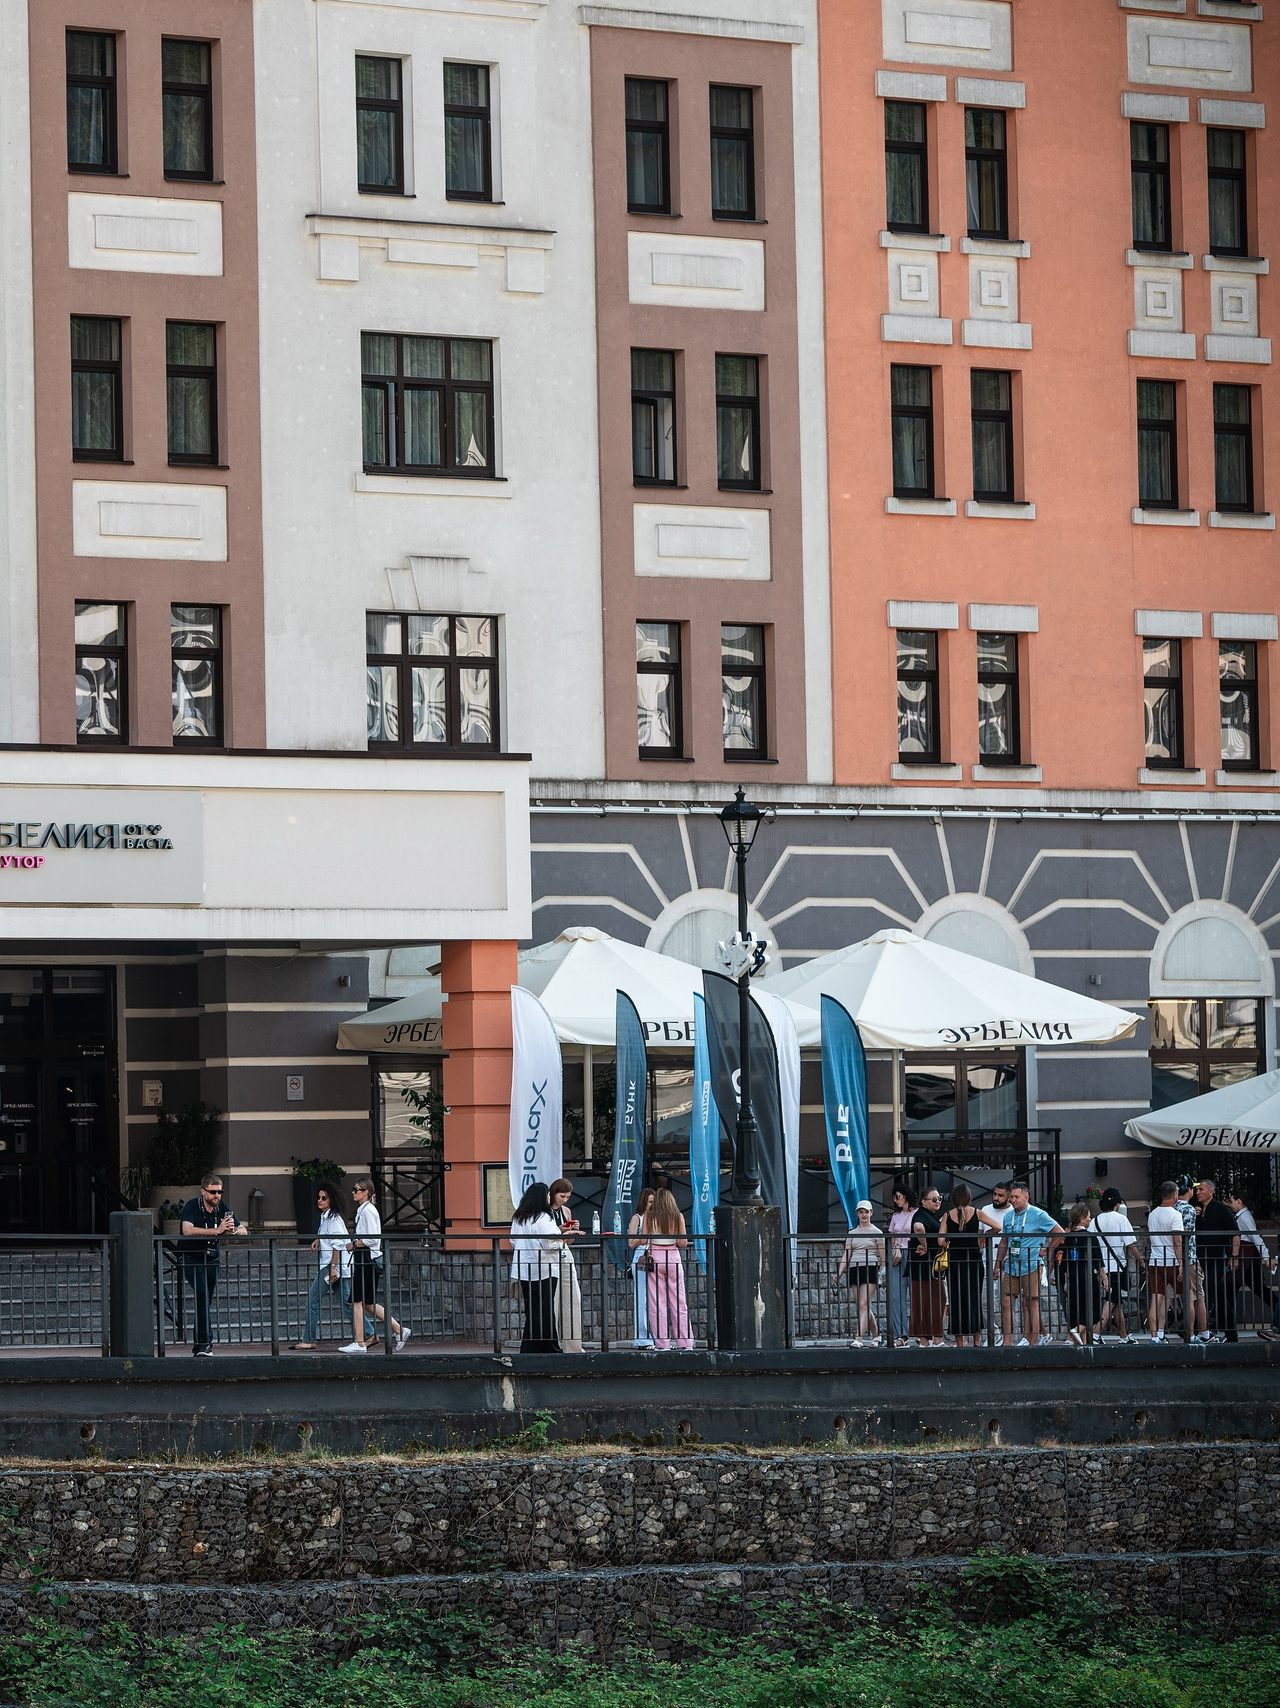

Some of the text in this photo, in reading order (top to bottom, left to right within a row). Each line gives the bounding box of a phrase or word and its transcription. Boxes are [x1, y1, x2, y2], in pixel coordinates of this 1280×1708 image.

[123, 824, 147, 836] ОТ
[123, 838, 174, 850] ВАСТА
[937, 1020, 1073, 1044] ЭРБЕЛИЯ
[1176, 1127, 1278, 1149] ЭРБЕЛИЯ
